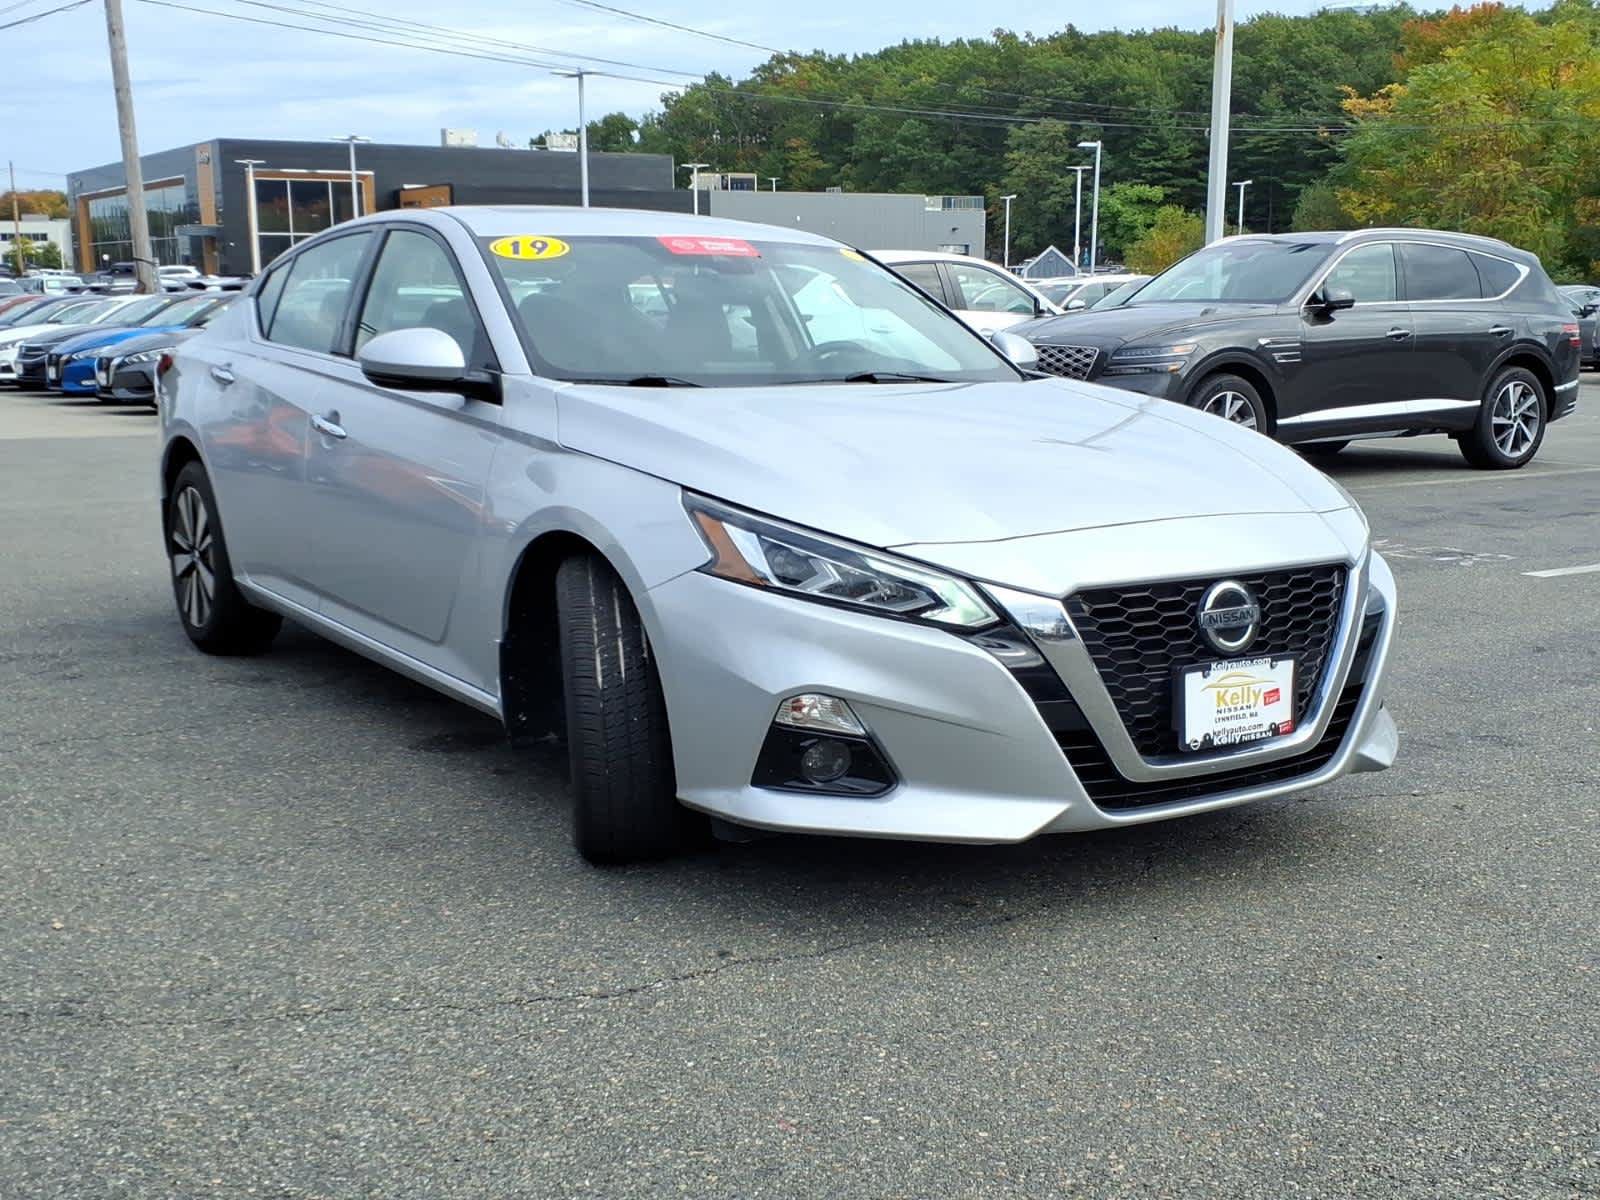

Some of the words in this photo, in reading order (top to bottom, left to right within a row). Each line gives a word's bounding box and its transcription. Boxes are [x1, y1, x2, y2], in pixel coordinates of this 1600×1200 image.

[511, 240, 548, 256] 19
[1208, 609, 1254, 626] NISSAN
[1216, 686, 1262, 708] Kelly
[1216, 704, 1252, 715] NISSAN
[1212, 723, 1264, 737] kellyauto.com
[1213, 733, 1240, 746] Kelly
[1241, 729, 1272, 742] NISSAN
